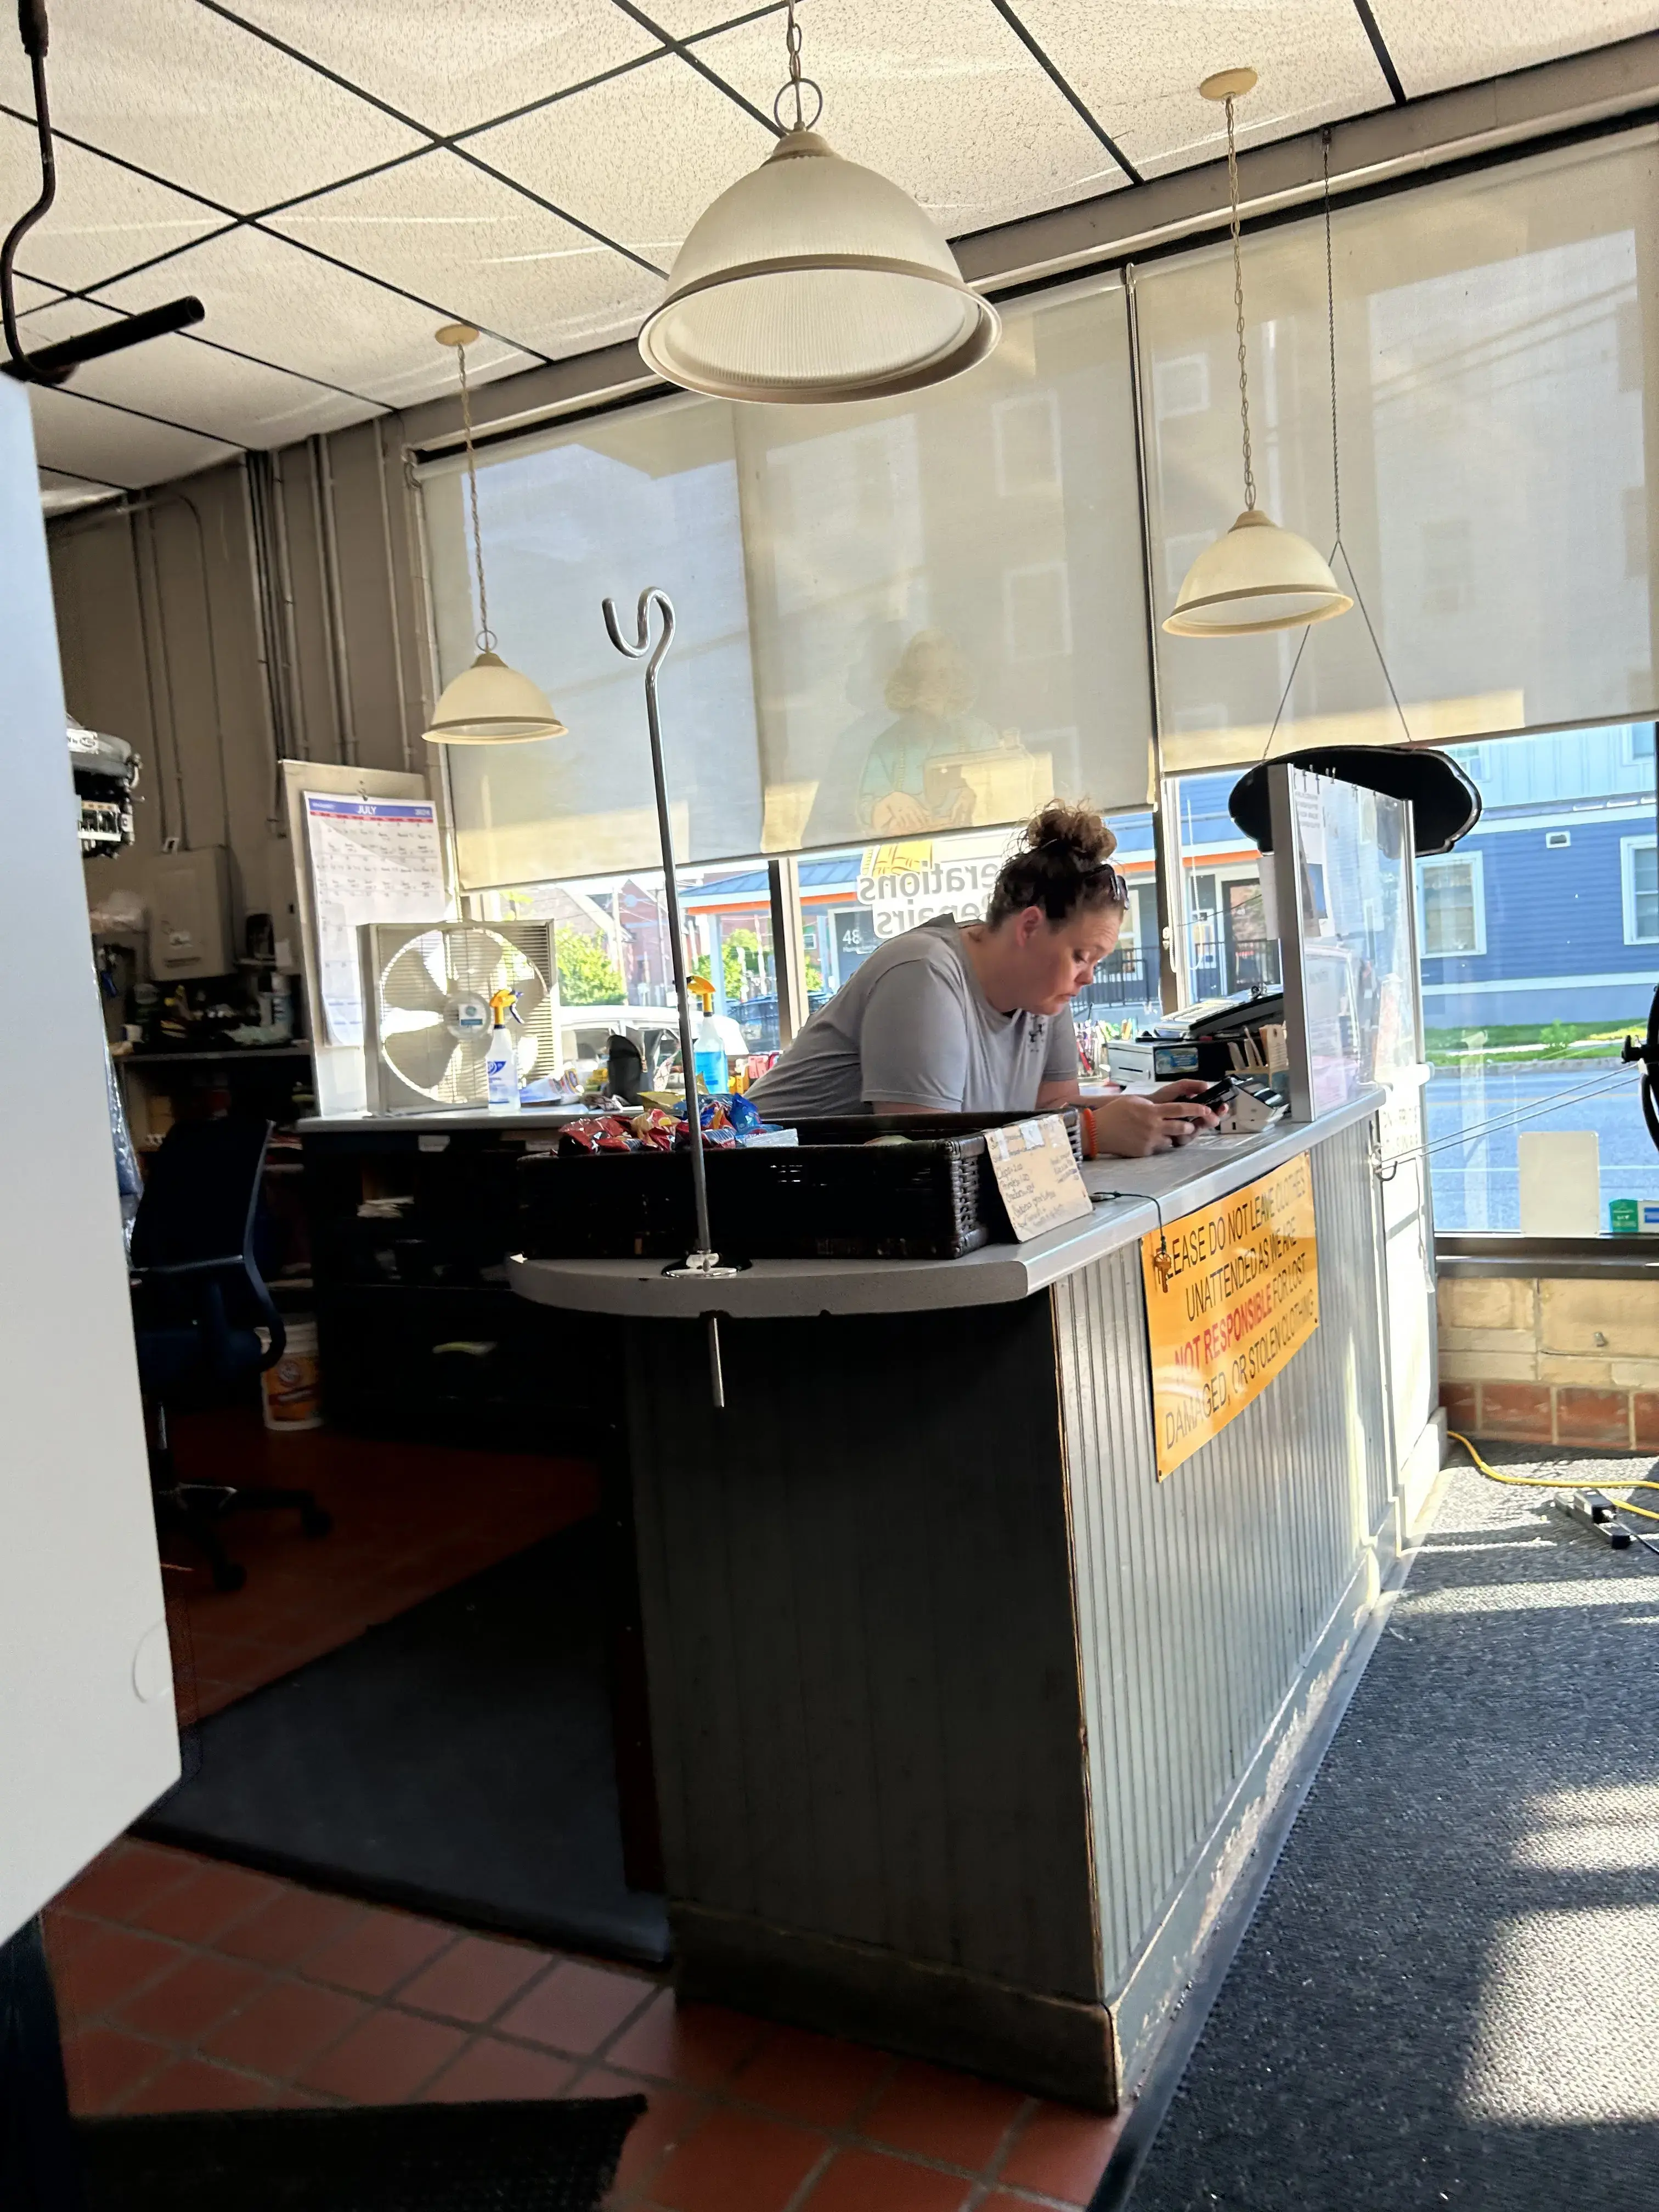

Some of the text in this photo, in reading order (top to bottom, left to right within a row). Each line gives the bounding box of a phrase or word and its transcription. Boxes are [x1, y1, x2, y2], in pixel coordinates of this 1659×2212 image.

[358, 805, 377, 815] JULY
[1186, 1216, 1297, 1322] UNATTENDED AS WE ARE
[1209, 1217, 1226, 1255] DO
[1228, 1203, 1248, 1245] NOT
[1250, 1187, 1274, 1231] LEAVE
[1165, 1288, 1313, 1449] DAMAGED, OR STOLEN CLOTHING
[1175, 1252, 1305, 1386] NOT RESPONSIBLE FOR LOST
